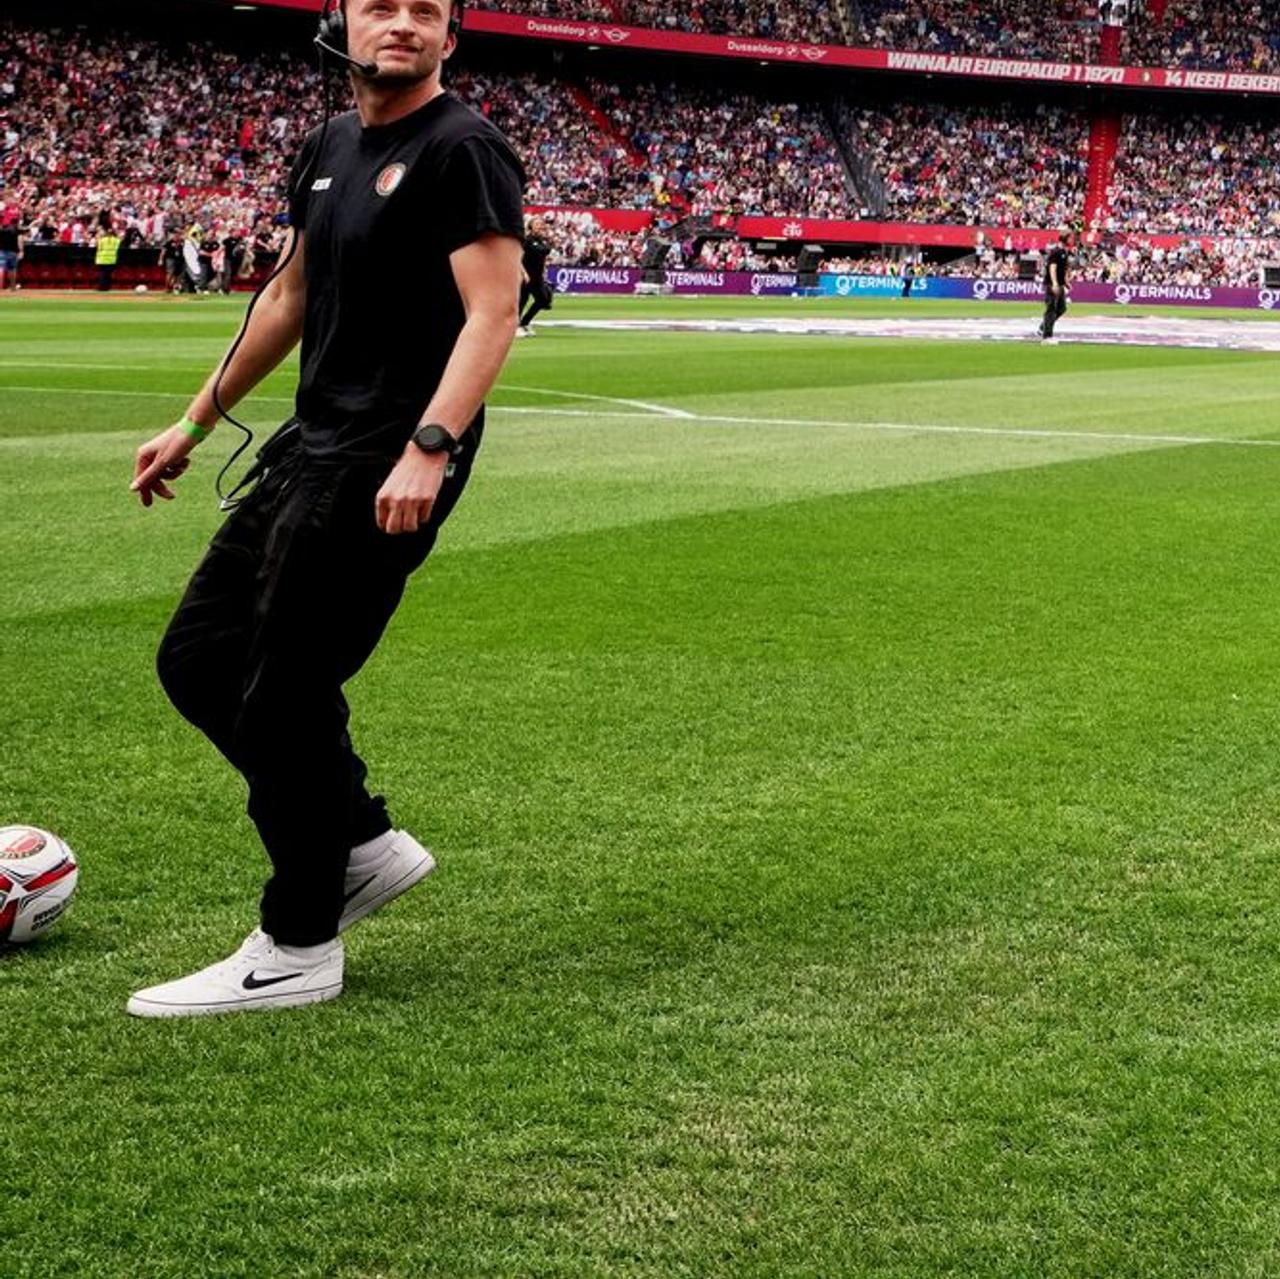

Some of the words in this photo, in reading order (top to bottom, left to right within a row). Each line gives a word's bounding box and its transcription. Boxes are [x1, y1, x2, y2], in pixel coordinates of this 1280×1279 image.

[527, 21, 585, 36] Dusseldorp
[727, 41, 783, 56] Dusseldorp
[887, 52, 972, 72] WINNAAR
[974, 59, 1071, 80] EUROPACUP
[1084, 66, 1125, 82] 1970
[1164, 71, 1182, 87] 14
[1183, 71, 1226, 89] KEER
[556, 268, 629, 293] QTERMINALS
[751, 273, 797, 295] QTERMINA
[973, 279, 1044, 300] QTERMIN
[1115, 284, 1211, 304] QTERMINALS
